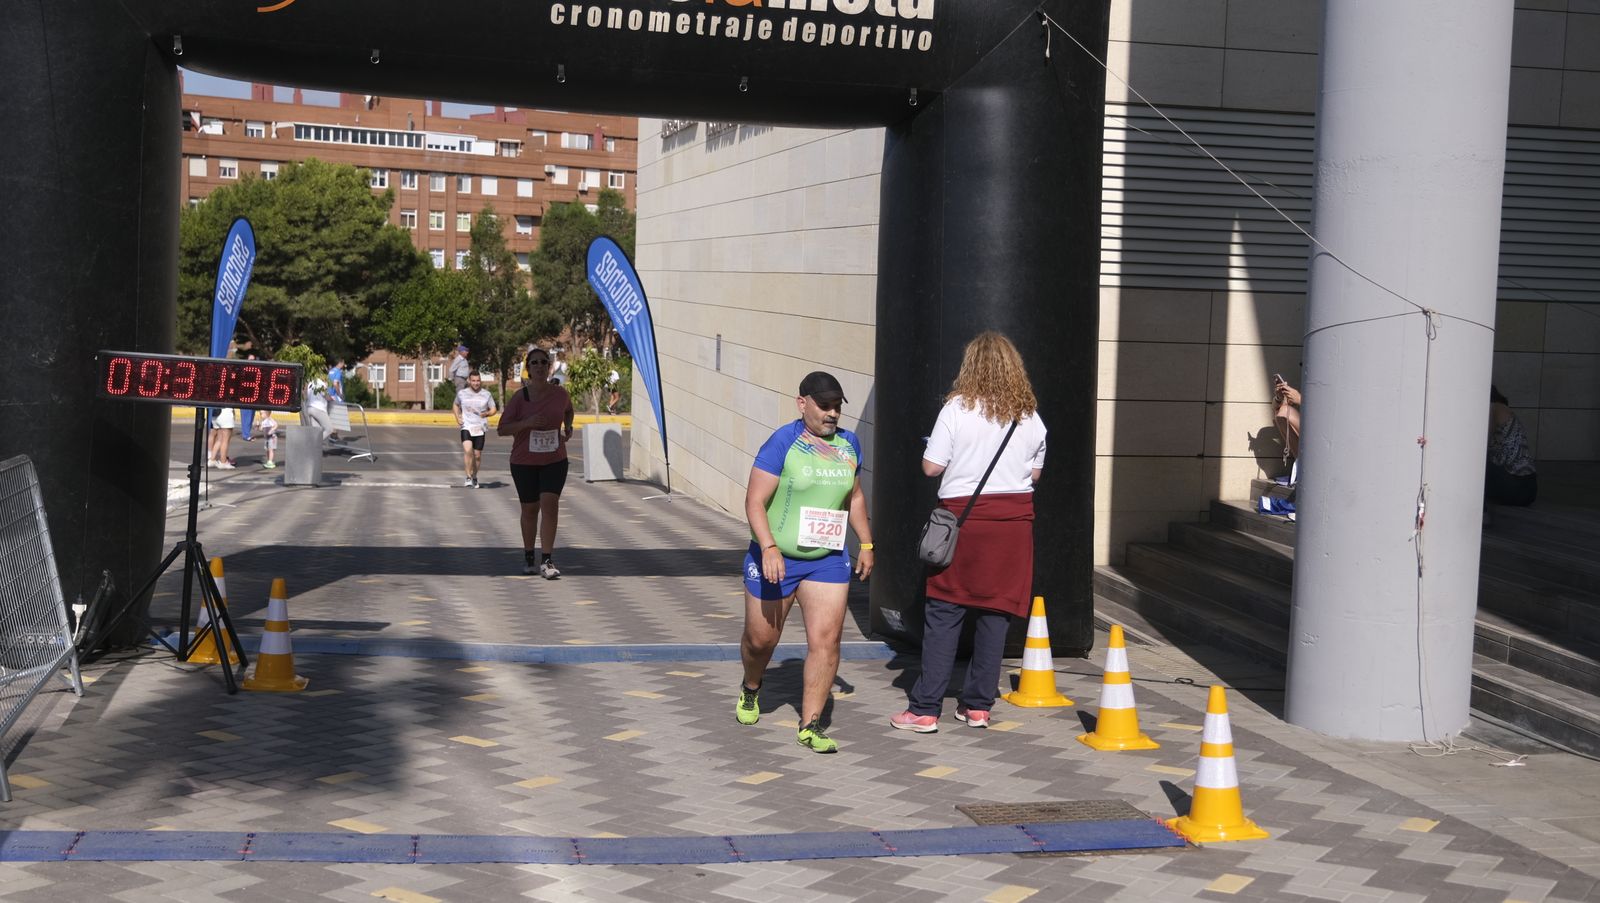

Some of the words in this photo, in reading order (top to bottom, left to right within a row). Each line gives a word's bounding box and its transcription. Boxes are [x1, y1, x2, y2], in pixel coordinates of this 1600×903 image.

[550, 3, 773, 41] cronometraje
[782, 17, 933, 52] deportivo
[815, 468, 852, 478] SAKATA
[807, 521, 843, 537] 1220
